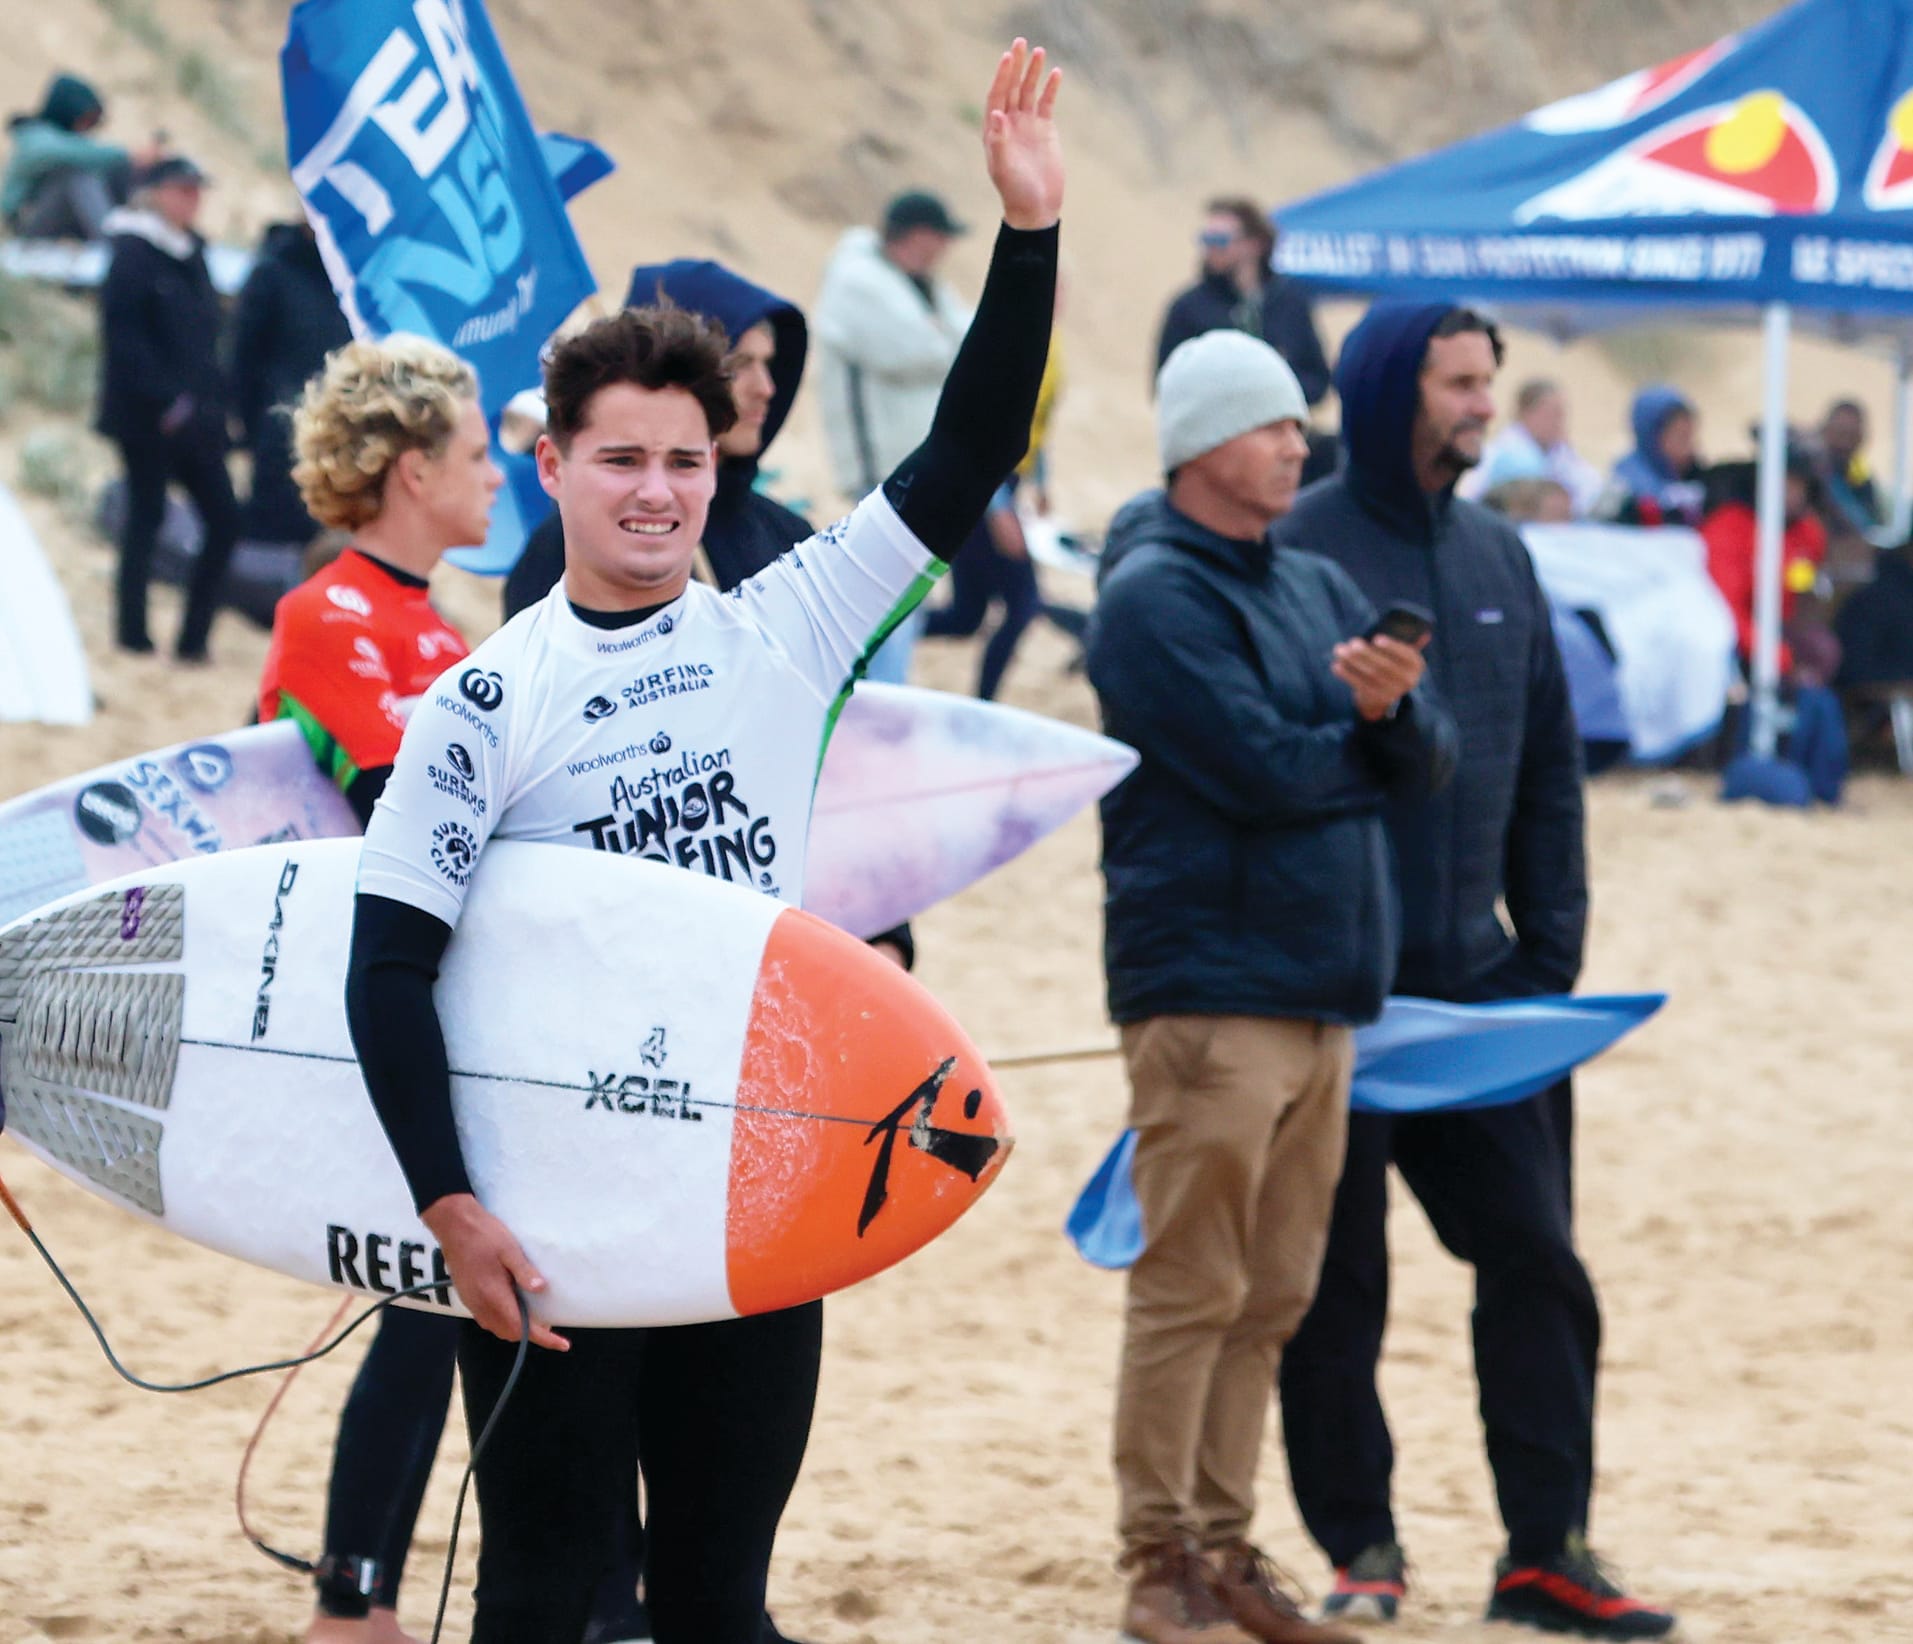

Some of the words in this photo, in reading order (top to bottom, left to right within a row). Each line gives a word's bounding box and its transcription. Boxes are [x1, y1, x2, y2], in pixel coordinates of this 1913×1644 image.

[291, 0, 476, 238] TEA
[628, 678, 711, 709] AUSTRALIA
[566, 744, 648, 777] Woolworths
[610, 748, 731, 812] Australian
[433, 780, 480, 818] AUSTRIA
[642, 816, 776, 883] FING
[251, 858, 299, 1042] DAKINE
[584, 1070, 702, 1121] XCEL
